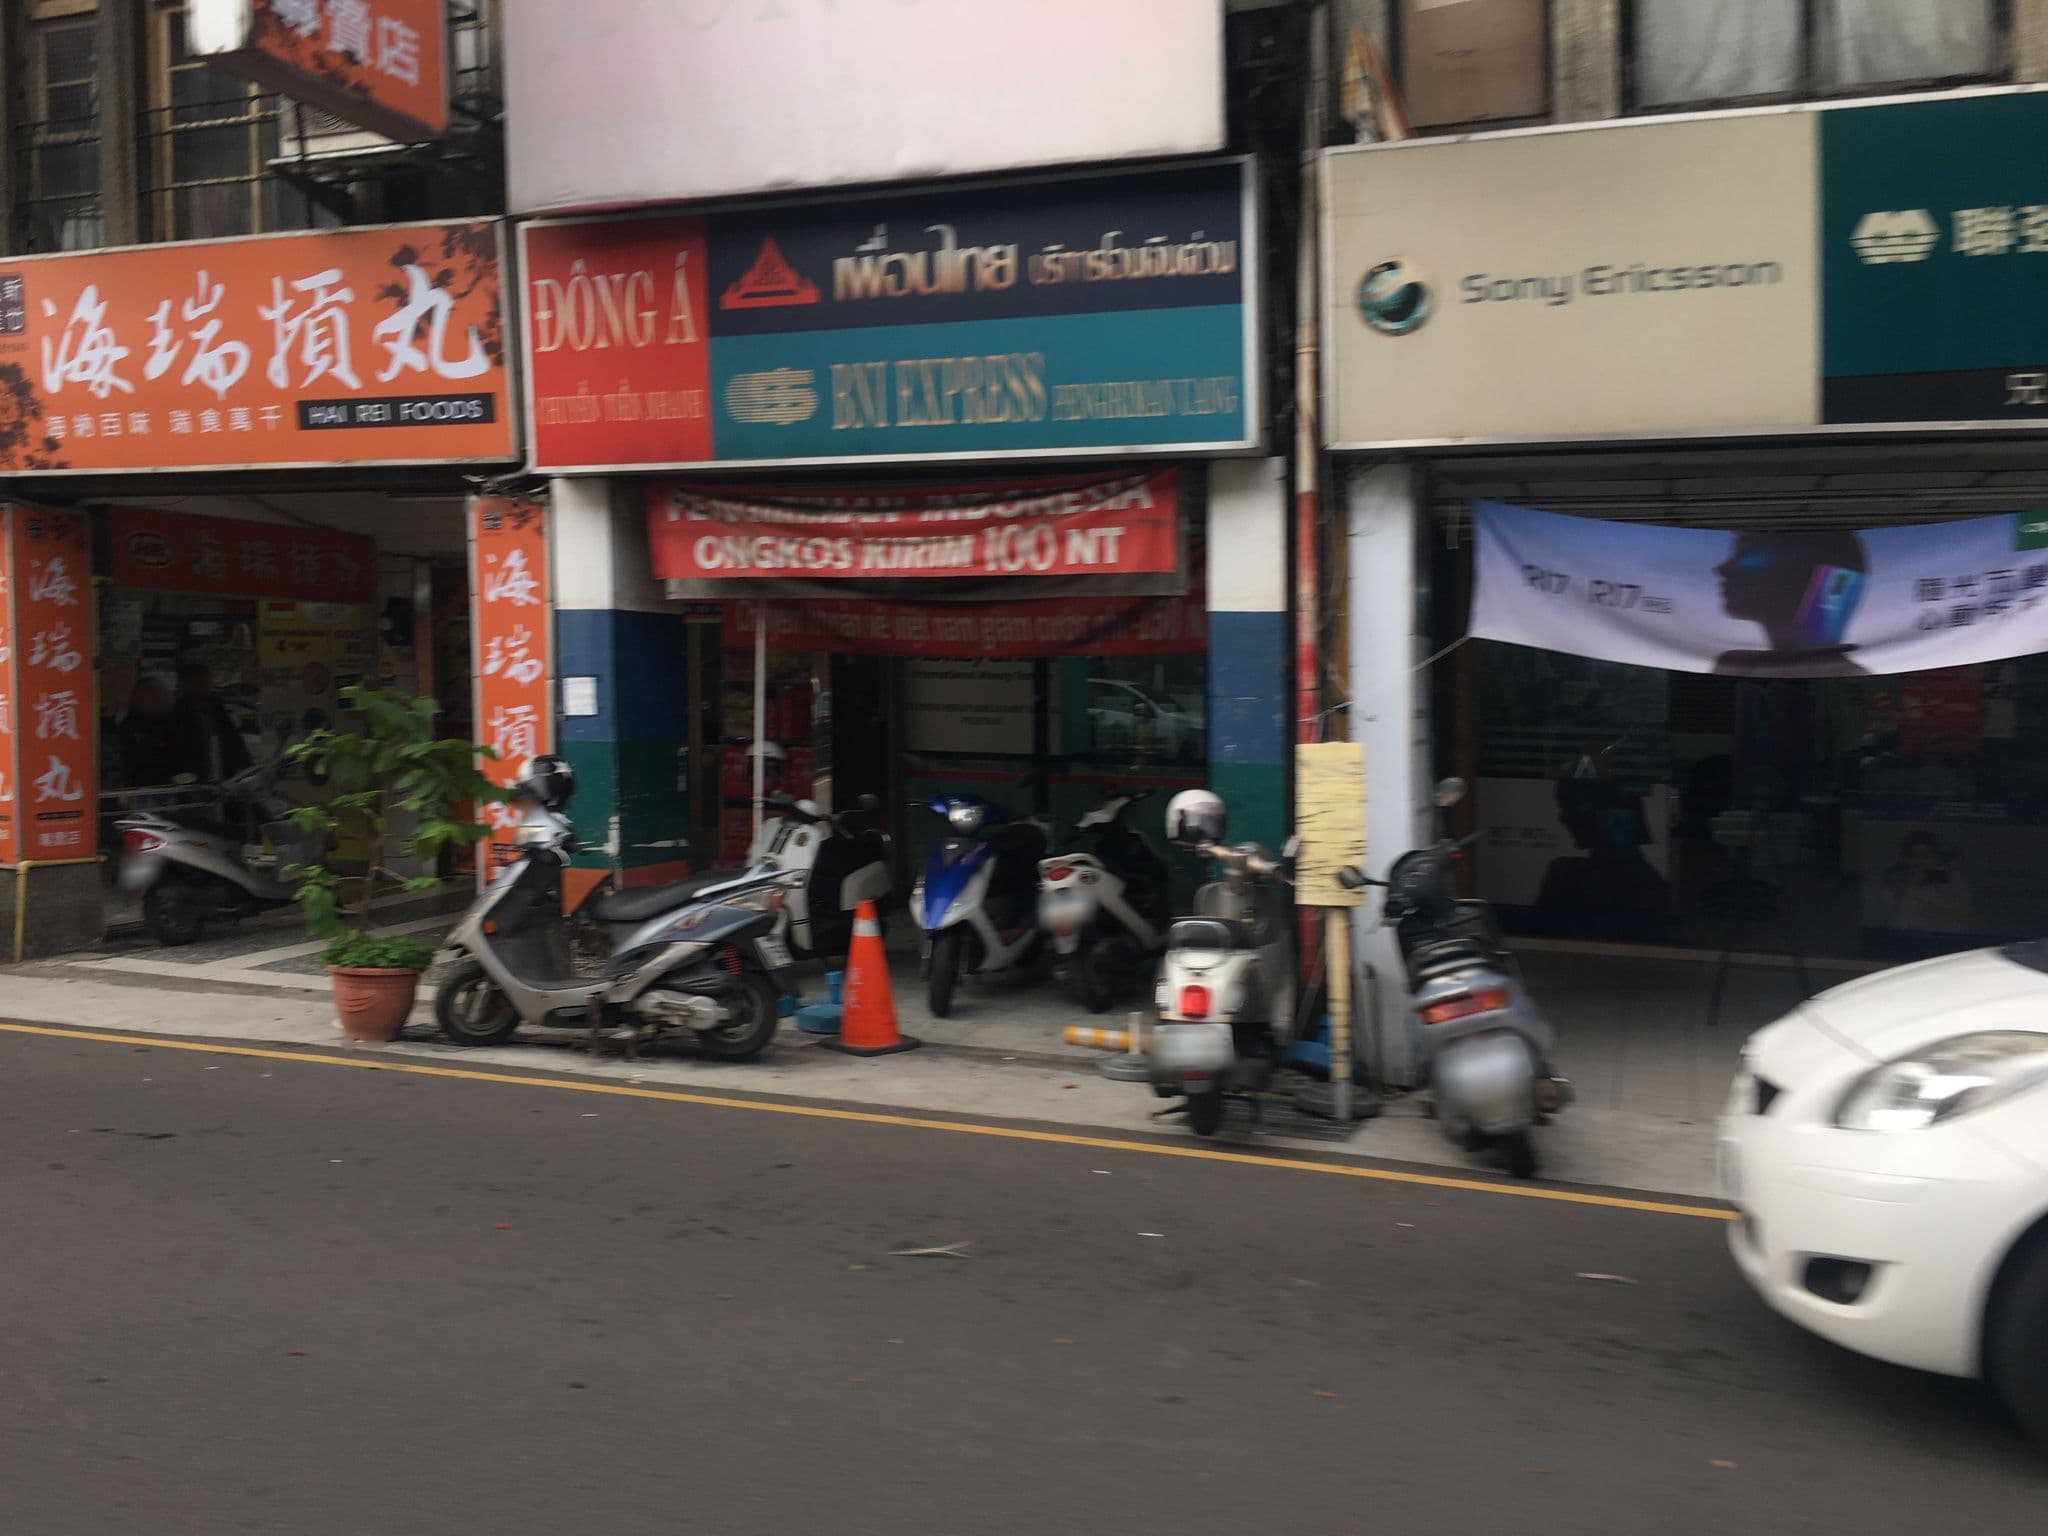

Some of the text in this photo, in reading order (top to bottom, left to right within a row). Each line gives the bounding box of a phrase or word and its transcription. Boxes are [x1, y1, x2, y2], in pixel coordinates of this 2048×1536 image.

[532, 250, 699, 353] ĐÔNG Á
[1461, 261, 1783, 306] Sony Ericsson
[308, 398, 483, 425] HAI REI FOODS
[831, 351, 1047, 430] BNI EXPRESS
[693, 534, 854, 571] ONGKOS
[983, 522, 1058, 573] 100
[1064, 527, 1126, 567] NT
